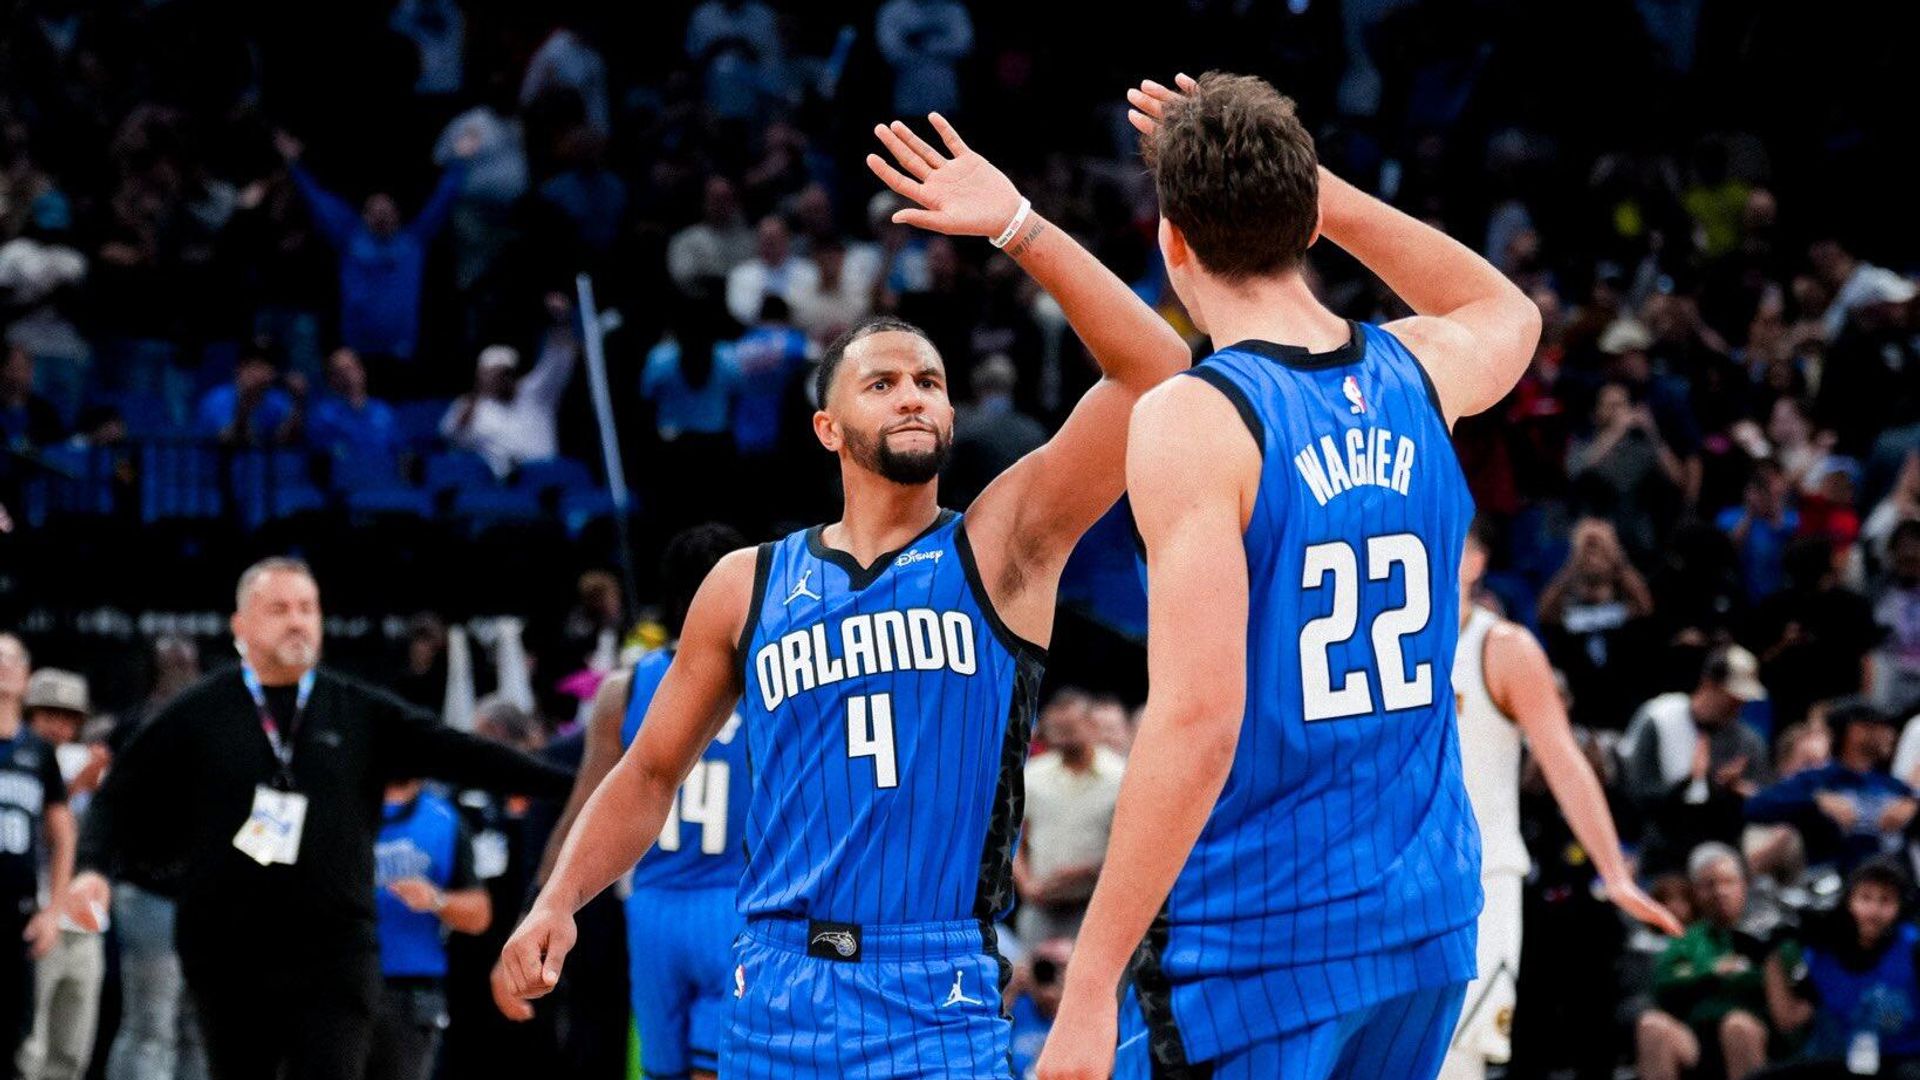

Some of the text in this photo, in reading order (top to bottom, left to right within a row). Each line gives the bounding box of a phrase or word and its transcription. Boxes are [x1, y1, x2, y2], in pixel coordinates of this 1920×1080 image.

[894, 549, 944, 567] Disney
[755, 608, 977, 712] ORLANDO
[1299, 532, 1433, 722] 22
[847, 692, 898, 789] 4
